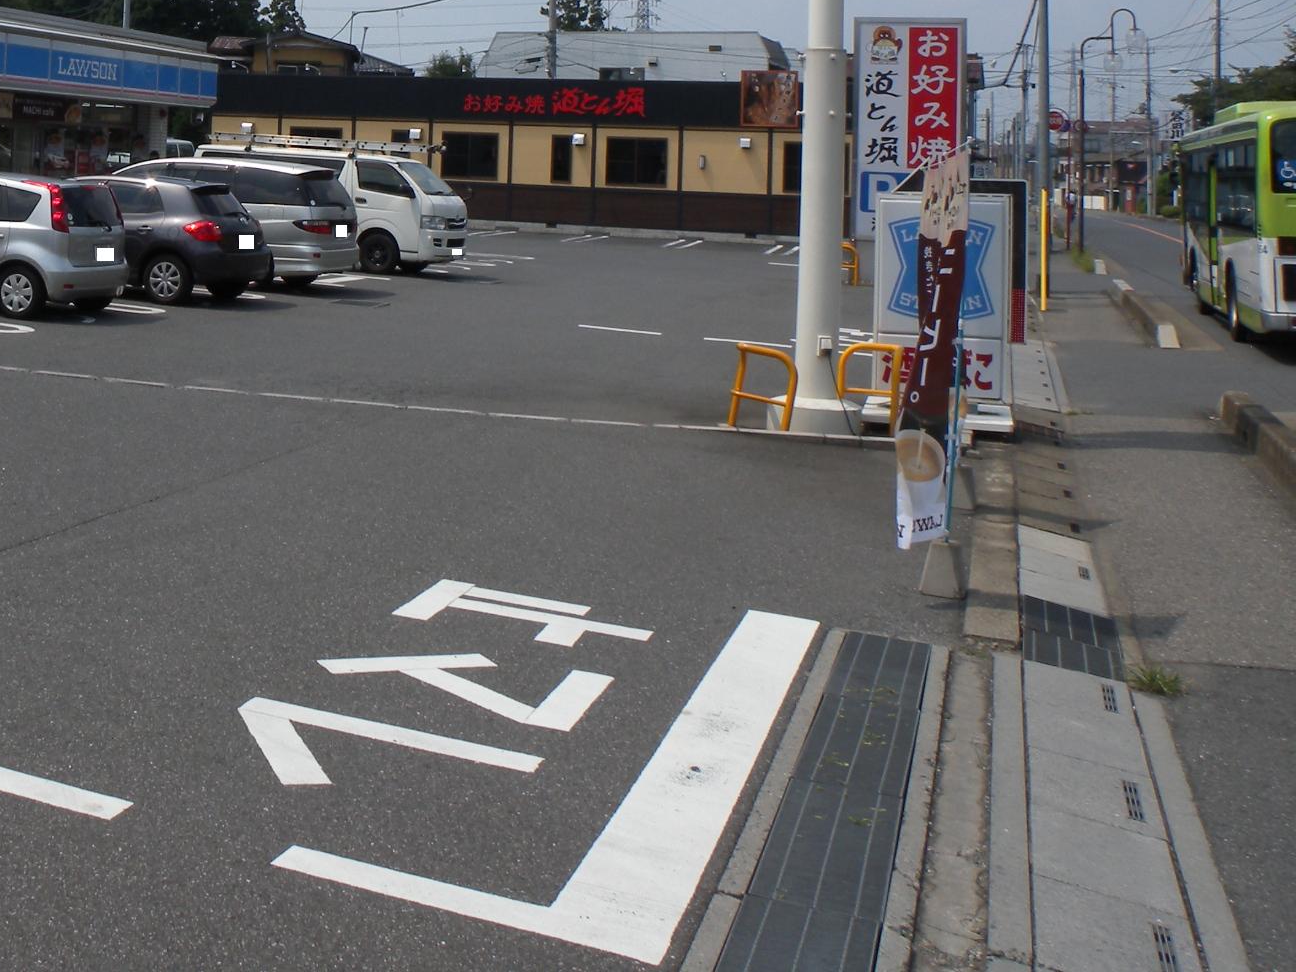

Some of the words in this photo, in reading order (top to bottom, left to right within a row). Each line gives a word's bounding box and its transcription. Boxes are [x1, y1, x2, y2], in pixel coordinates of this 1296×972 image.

[57, 56, 118, 81] LAWSON
[464, 93, 545, 115] お好み焼
[551, 86, 647, 118] 道とん堀
[865, 70, 902, 167] 道とん堀
